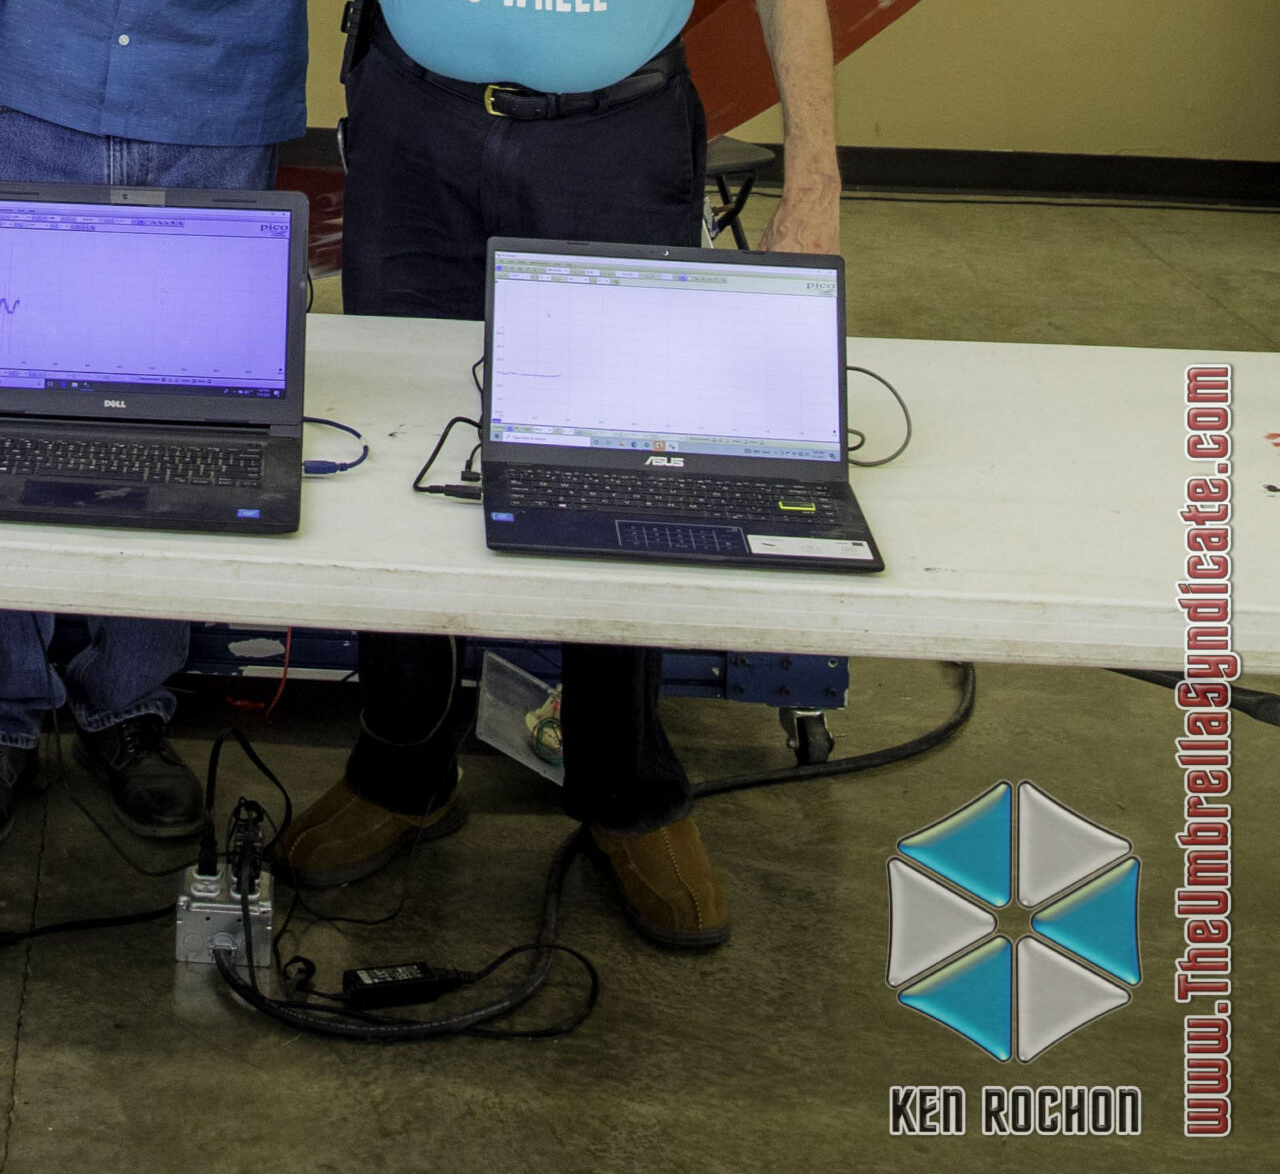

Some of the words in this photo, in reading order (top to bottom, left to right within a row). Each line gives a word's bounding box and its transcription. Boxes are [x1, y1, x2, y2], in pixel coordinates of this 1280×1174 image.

[260, 222, 289, 232] pico
[806, 281, 836, 290] pico
[104, 399, 127, 408] DELL
[644, 456, 685, 467] ASUS
